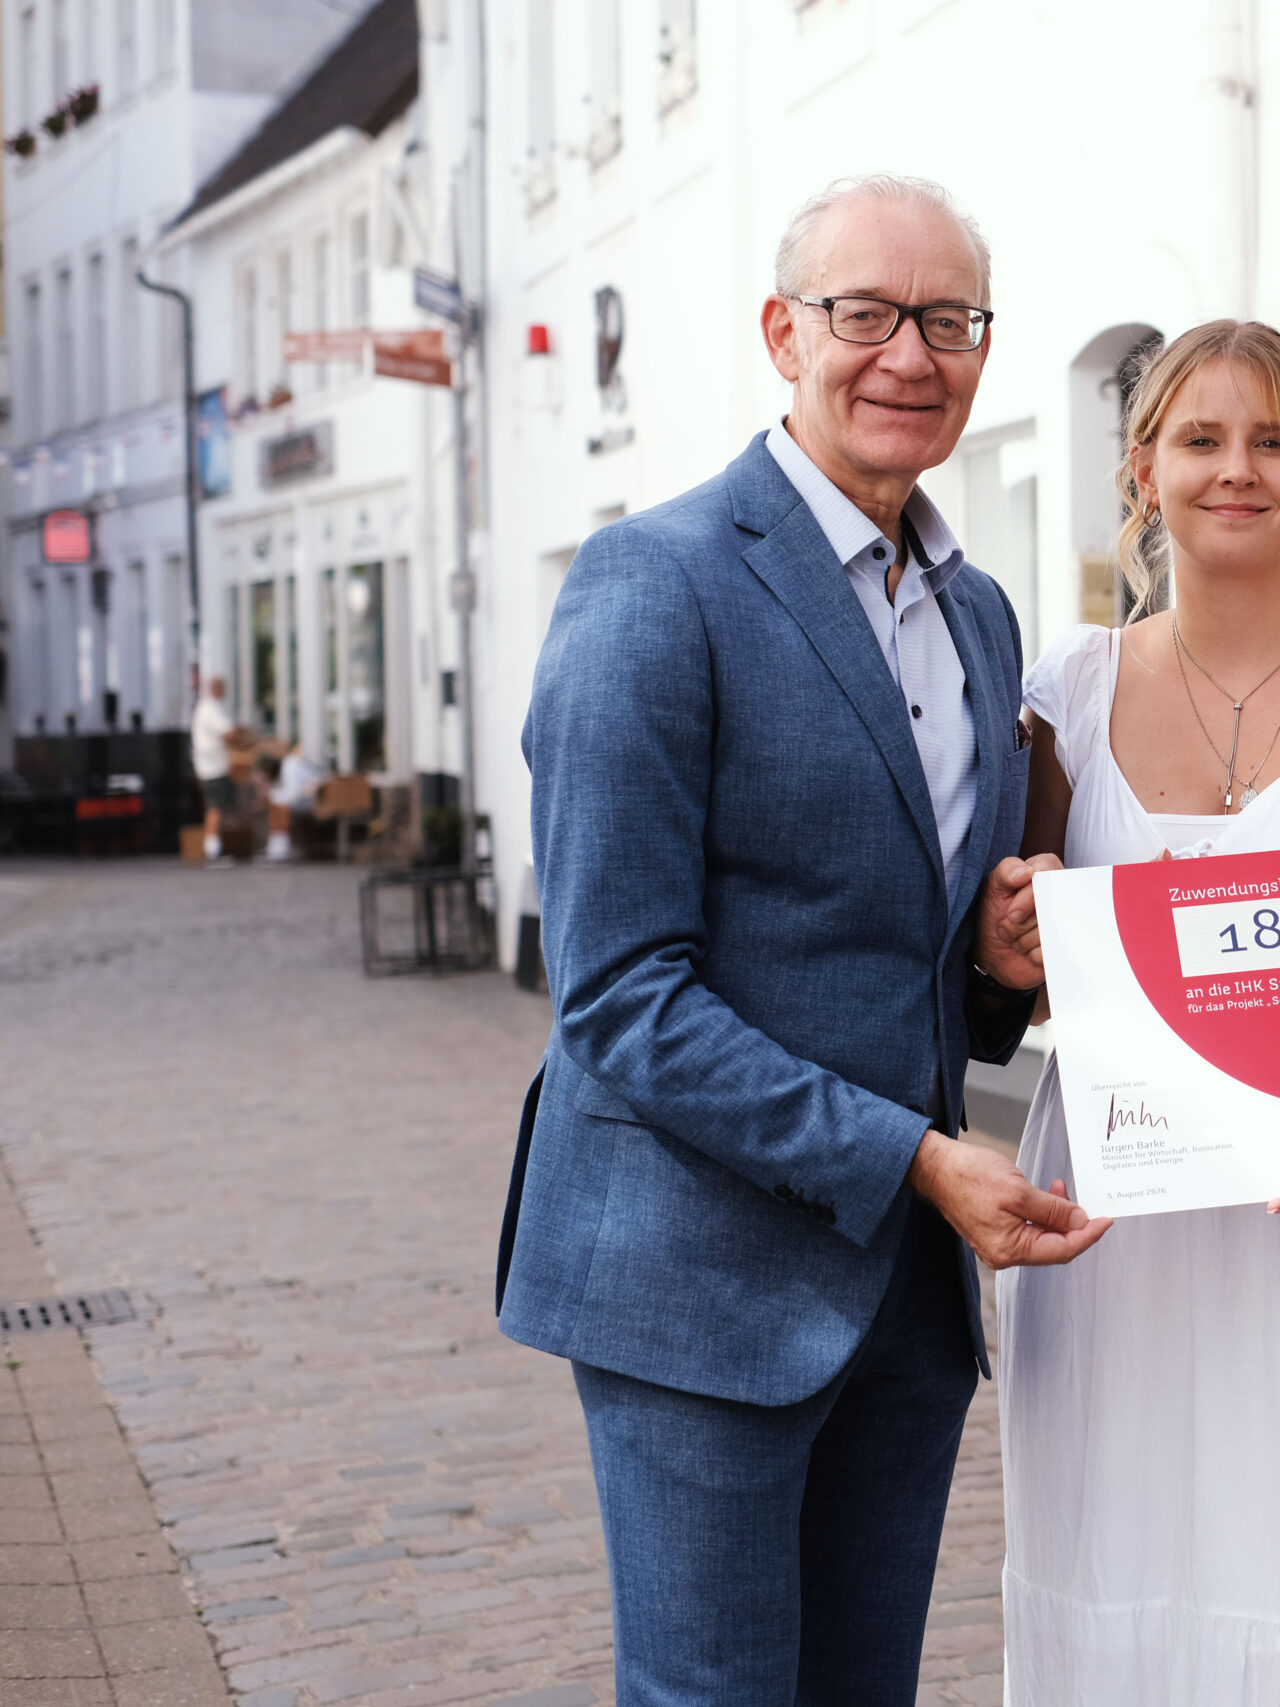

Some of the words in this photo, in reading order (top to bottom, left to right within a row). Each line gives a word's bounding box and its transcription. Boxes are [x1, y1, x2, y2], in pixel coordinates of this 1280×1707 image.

[1186, 987, 1204, 998] an
[1208, 983, 1231, 996] die
[1234, 979, 1265, 994] IHK
[1187, 1003, 1203, 1013] für
[1206, 1000, 1224, 1011] das
[1227, 998, 1263, 1010] Projekt
[1100, 1142, 1134, 1154] Jürgen
[1137, 1139, 1165, 1149] Barke
[1101, 1153, 1133, 1162] Minister
[1135, 1150, 1146, 1159] für
[1102, 1161, 1136, 1171] Digitales
[1138, 1158, 1154, 1167] und
[1155, 1156, 1183, 1165] Energie
[1117, 1190, 1144, 1200] August
